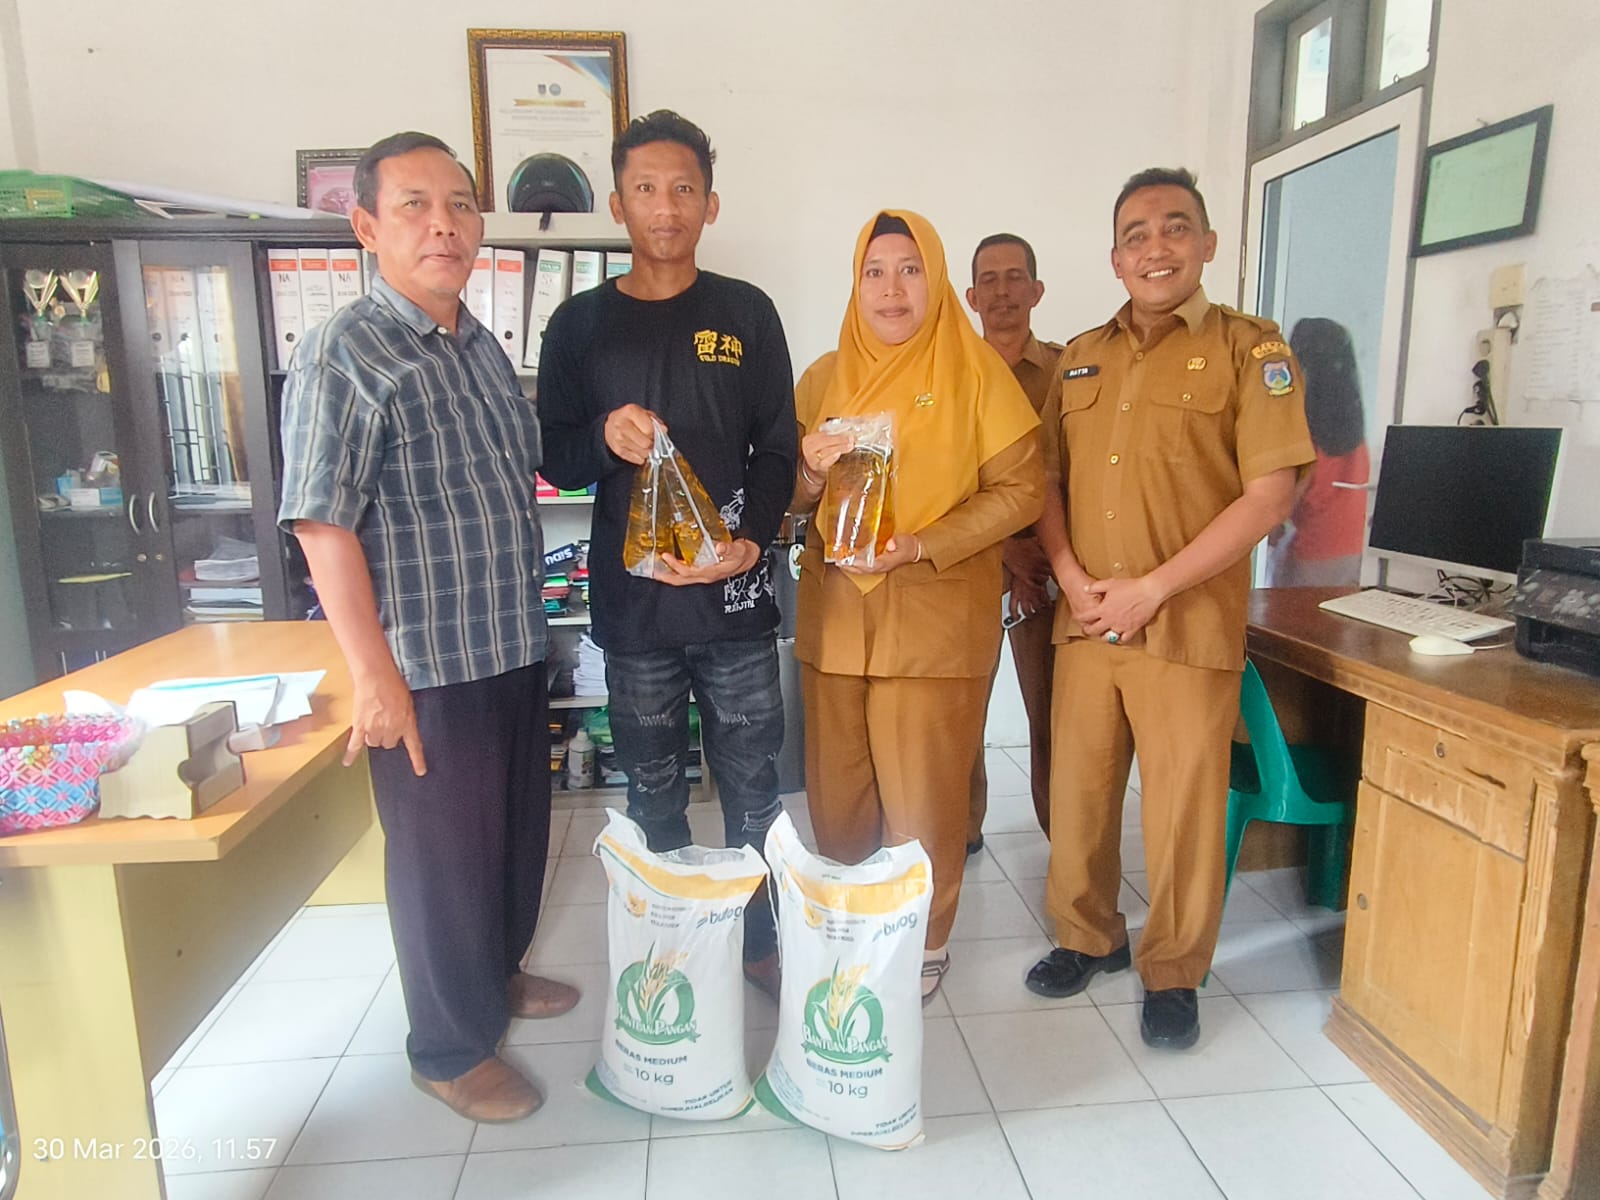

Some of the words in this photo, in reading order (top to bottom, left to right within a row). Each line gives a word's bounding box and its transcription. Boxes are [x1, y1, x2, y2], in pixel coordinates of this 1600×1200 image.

[644, 1055, 688, 1066] MEDIUM
[635, 1067, 650, 1082] 10
[653, 1072, 674, 1086] kg
[840, 1066, 884, 1080] MEDIUM
[828, 1081, 844, 1095] 10
[848, 1084, 868, 1098] kg
